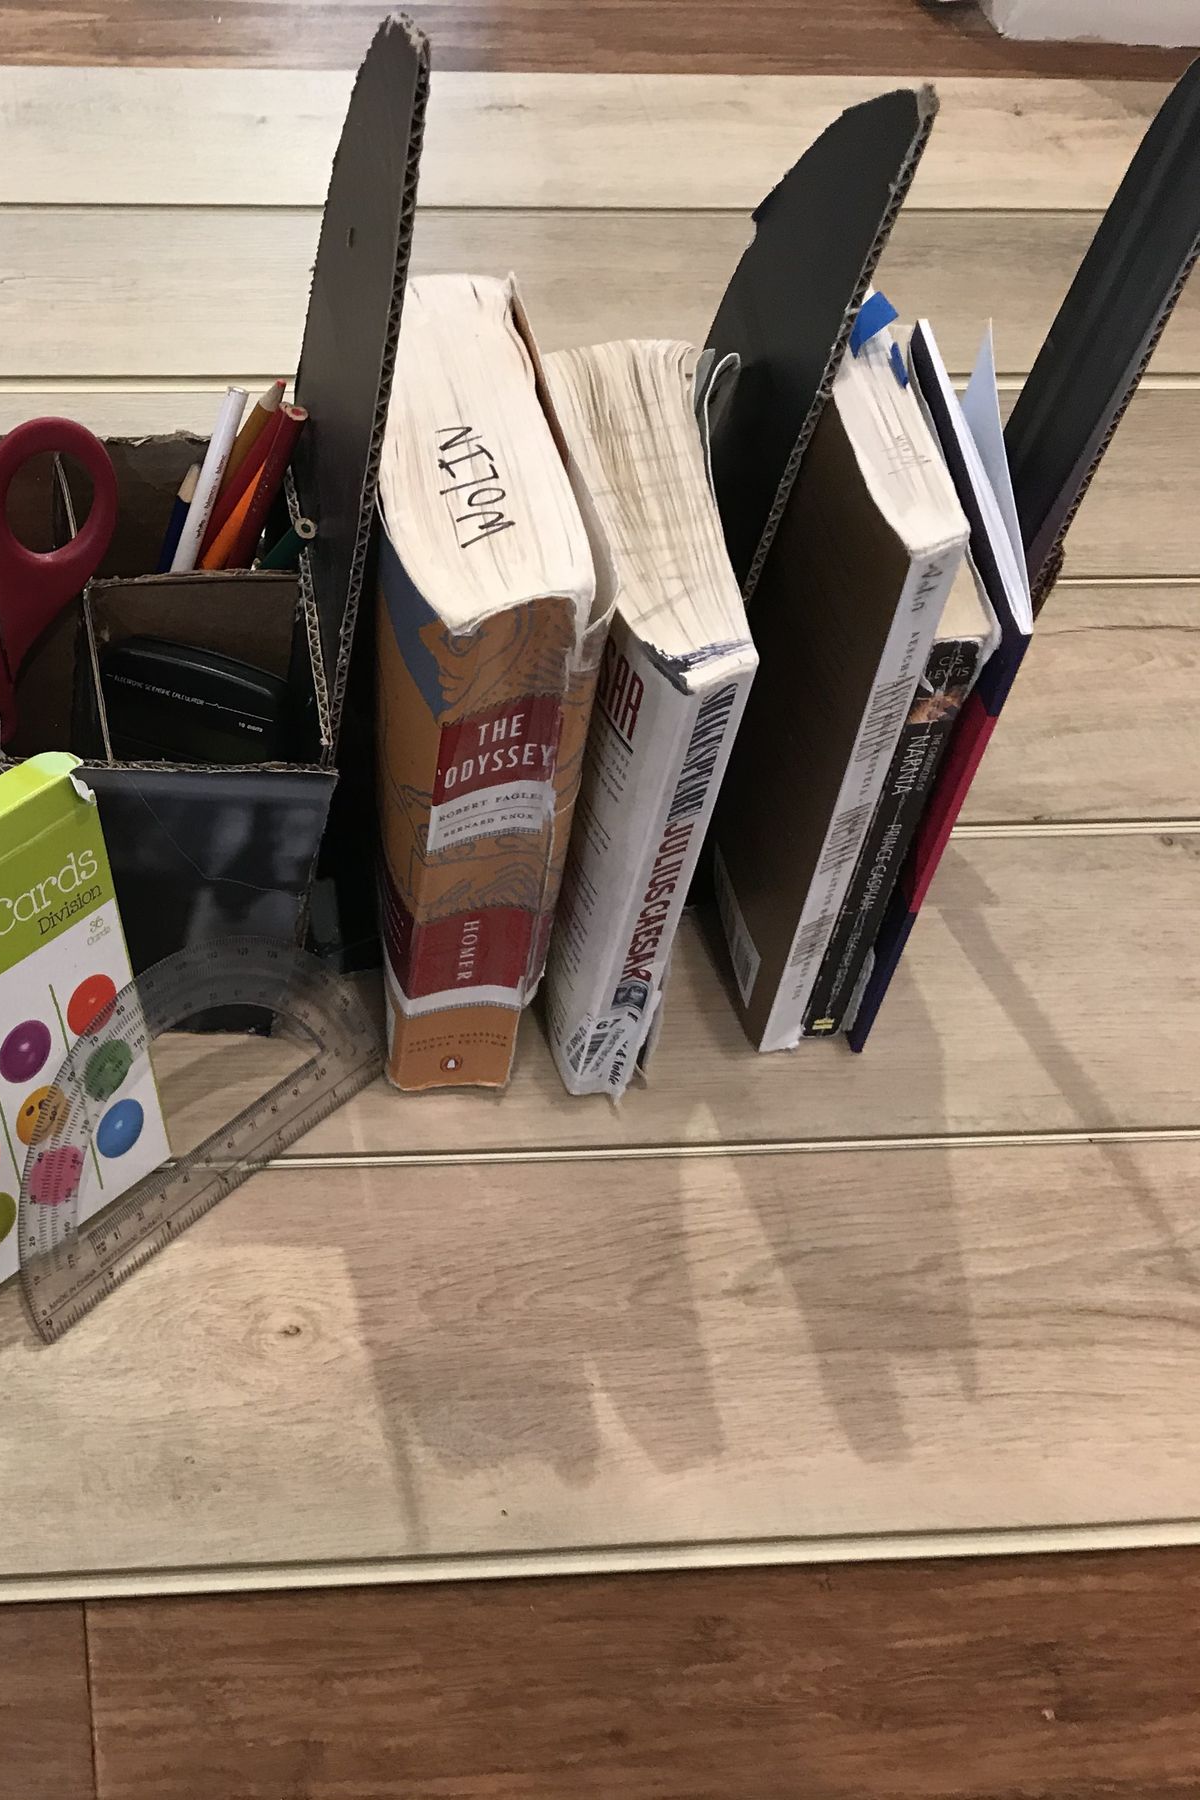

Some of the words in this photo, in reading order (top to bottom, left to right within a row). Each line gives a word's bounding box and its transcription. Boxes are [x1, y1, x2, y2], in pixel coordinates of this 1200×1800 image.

[928, 666, 970, 681] LEWIS
[171, 690, 206, 706] CALCULATOR
[478, 713, 525, 747] THE
[443, 743, 555, 789] ODYSSEY
[893, 734, 929, 799] NARNIA
[438, 799, 489, 823] ROBERT
[500, 811, 535, 823] KNOX
[641, 820, 695, 903] JULIUS
[876, 822, 903, 864] PRINCE
[39, 883, 102, 936] Division
[456, 919, 480, 981] HOMER
[619, 899, 671, 983] CAESAR
[89, 1036, 99, 1047] 70
[116, 1004, 125, 1016] 80
[133, 1035, 146, 1048] 100
[79, 1119, 90, 1135] 130
